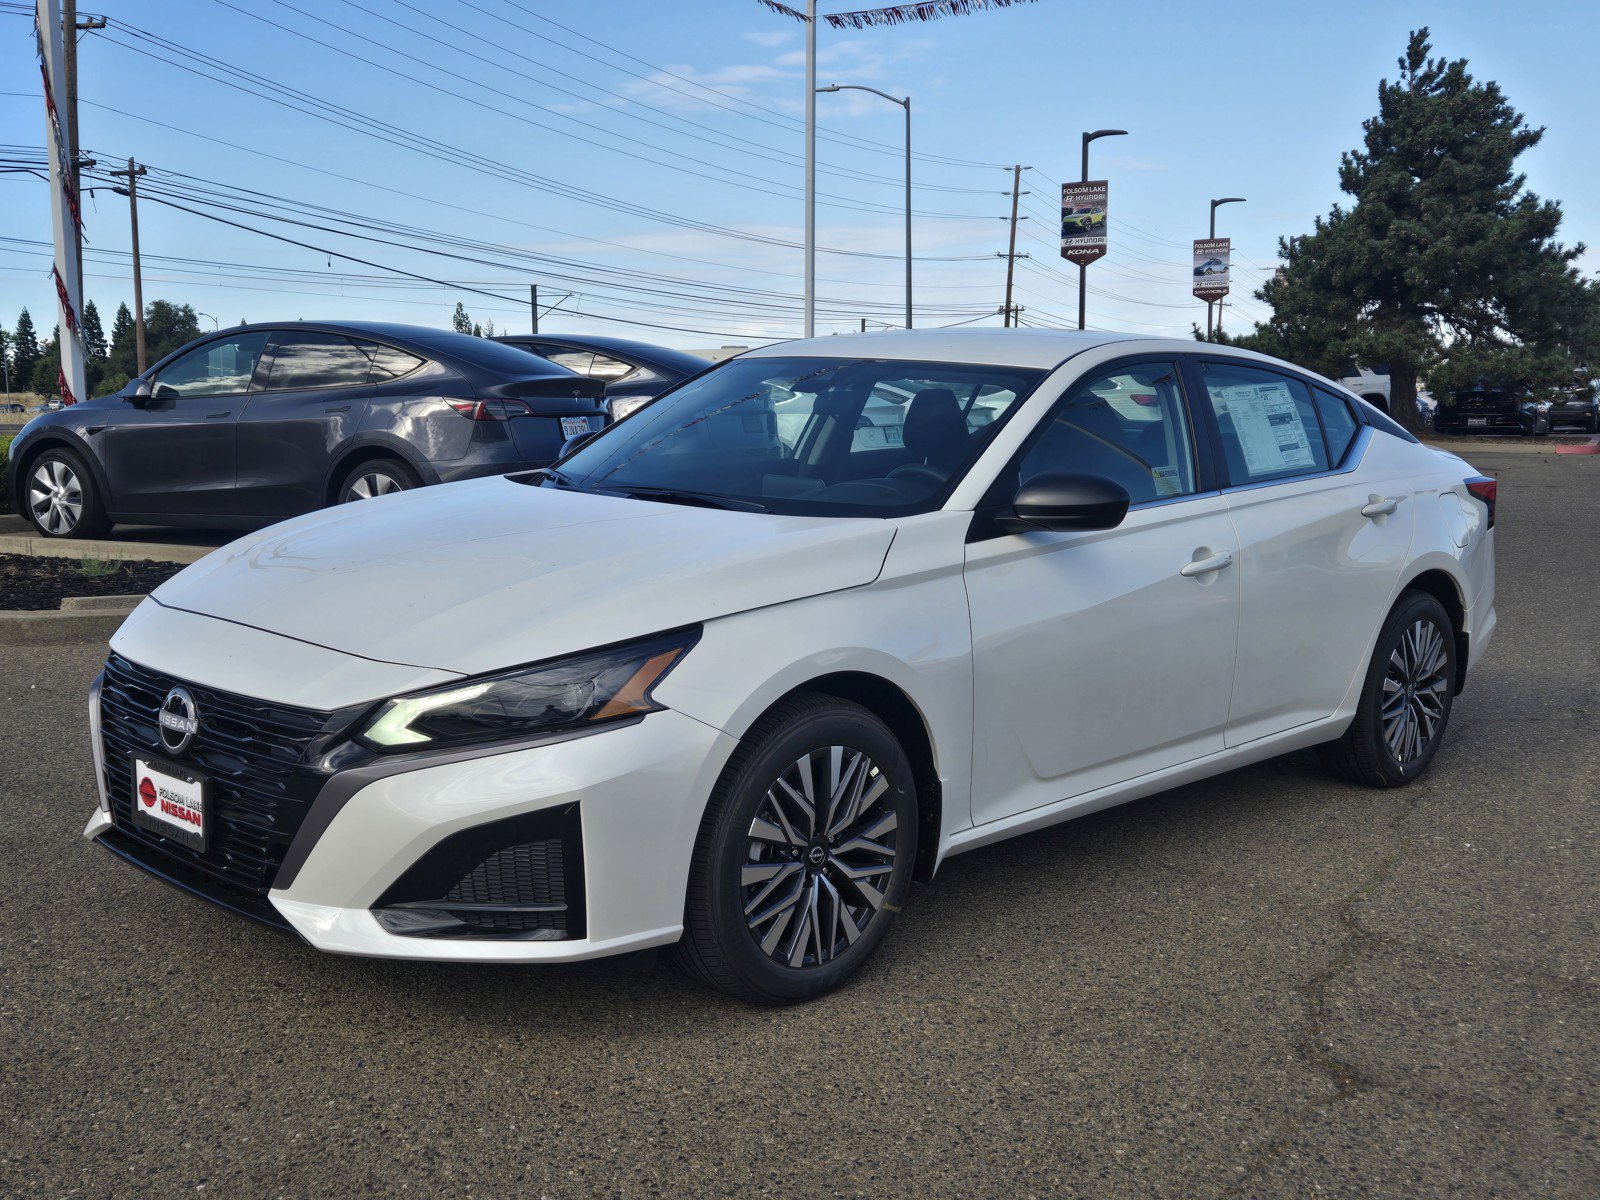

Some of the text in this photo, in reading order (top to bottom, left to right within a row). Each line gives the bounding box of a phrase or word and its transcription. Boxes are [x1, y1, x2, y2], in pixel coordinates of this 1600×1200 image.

[1063, 187, 1088, 195] FOLSOM
[159, 787, 203, 813] FOLSOM LAKE
[160, 799, 202, 827] NISSAN
